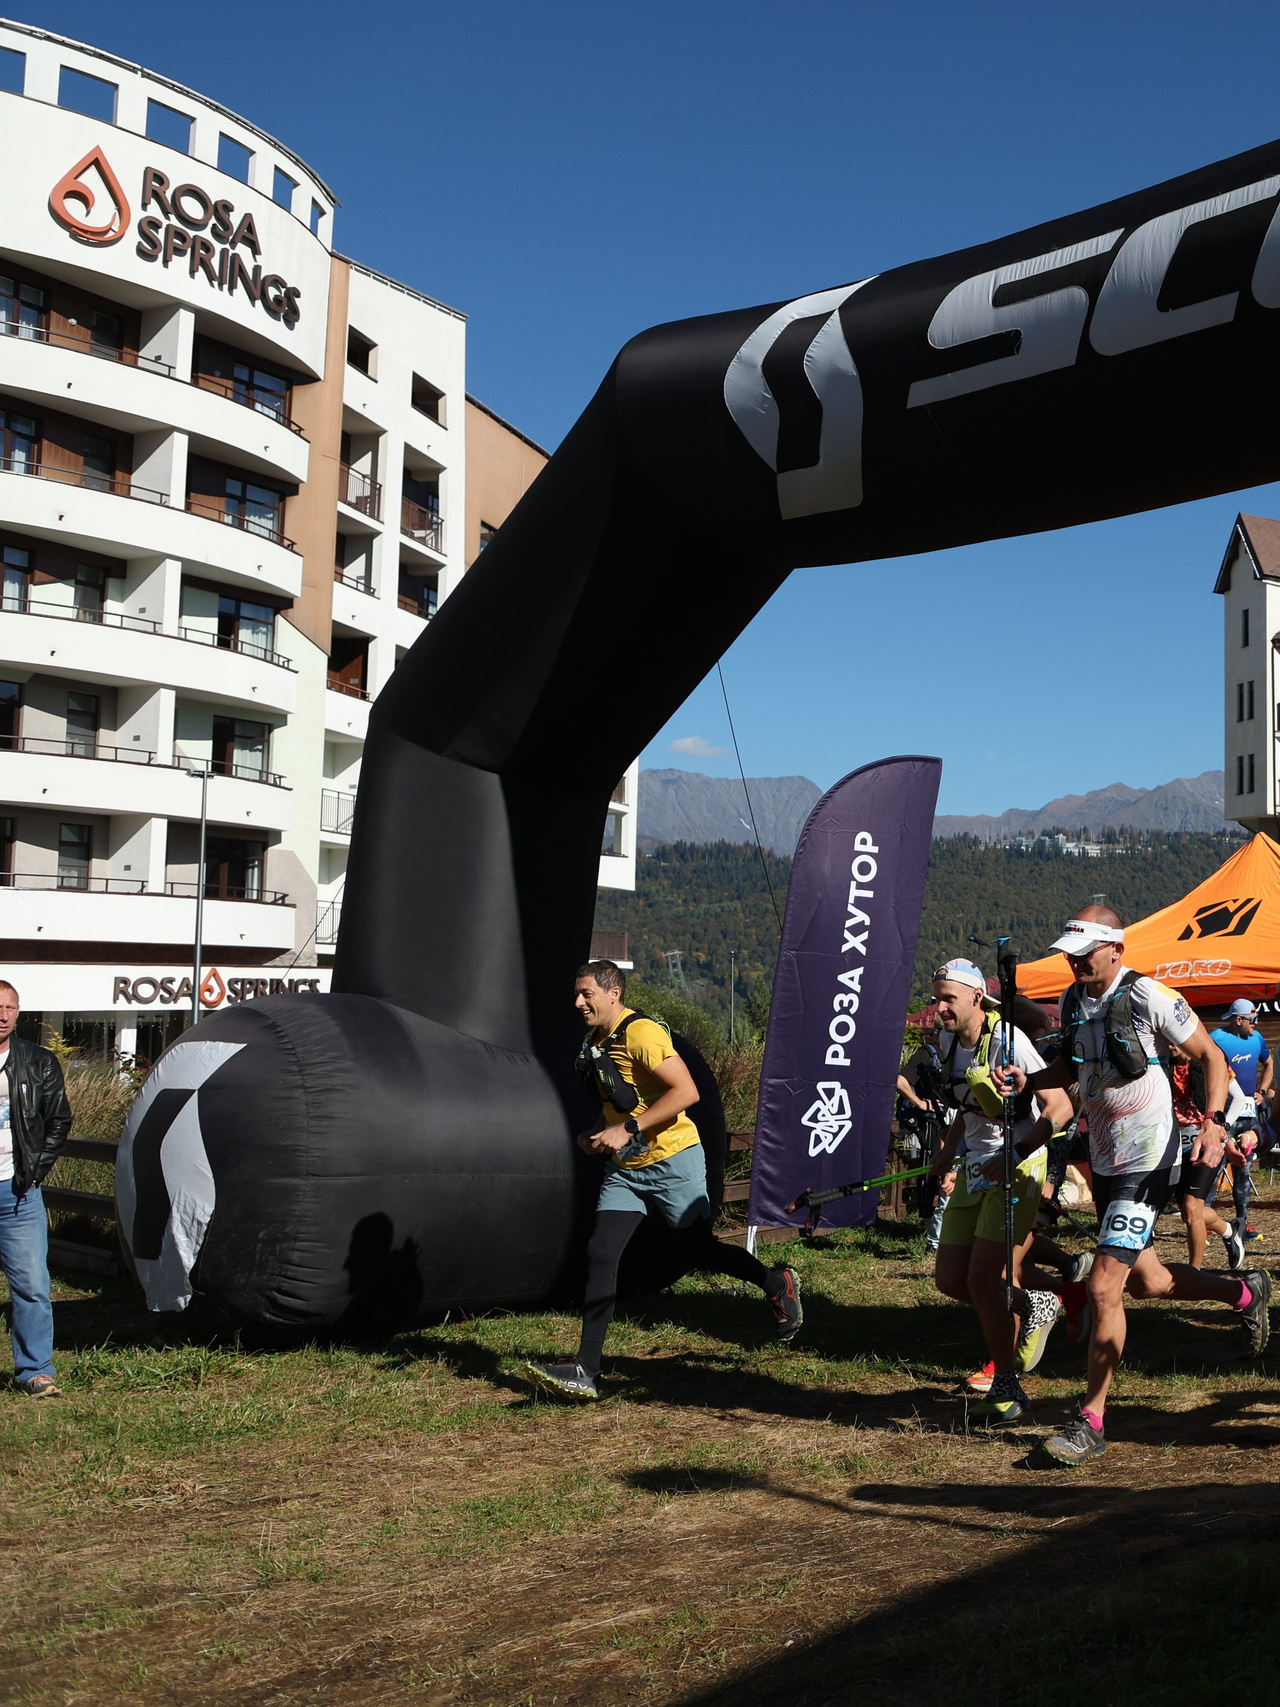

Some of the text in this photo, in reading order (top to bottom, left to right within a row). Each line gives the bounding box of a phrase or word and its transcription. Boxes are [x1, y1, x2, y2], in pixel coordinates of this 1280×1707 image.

[141, 166, 262, 260] ROSA
[136, 216, 301, 326] SPRINGS
[825, 831, 879, 1066] РОЗА ХУТОР
[1154, 959, 1231, 979] YOKO
[113, 976, 320, 1004] ROSA SPRINGS
[1105, 1214, 1147, 1235] 169
